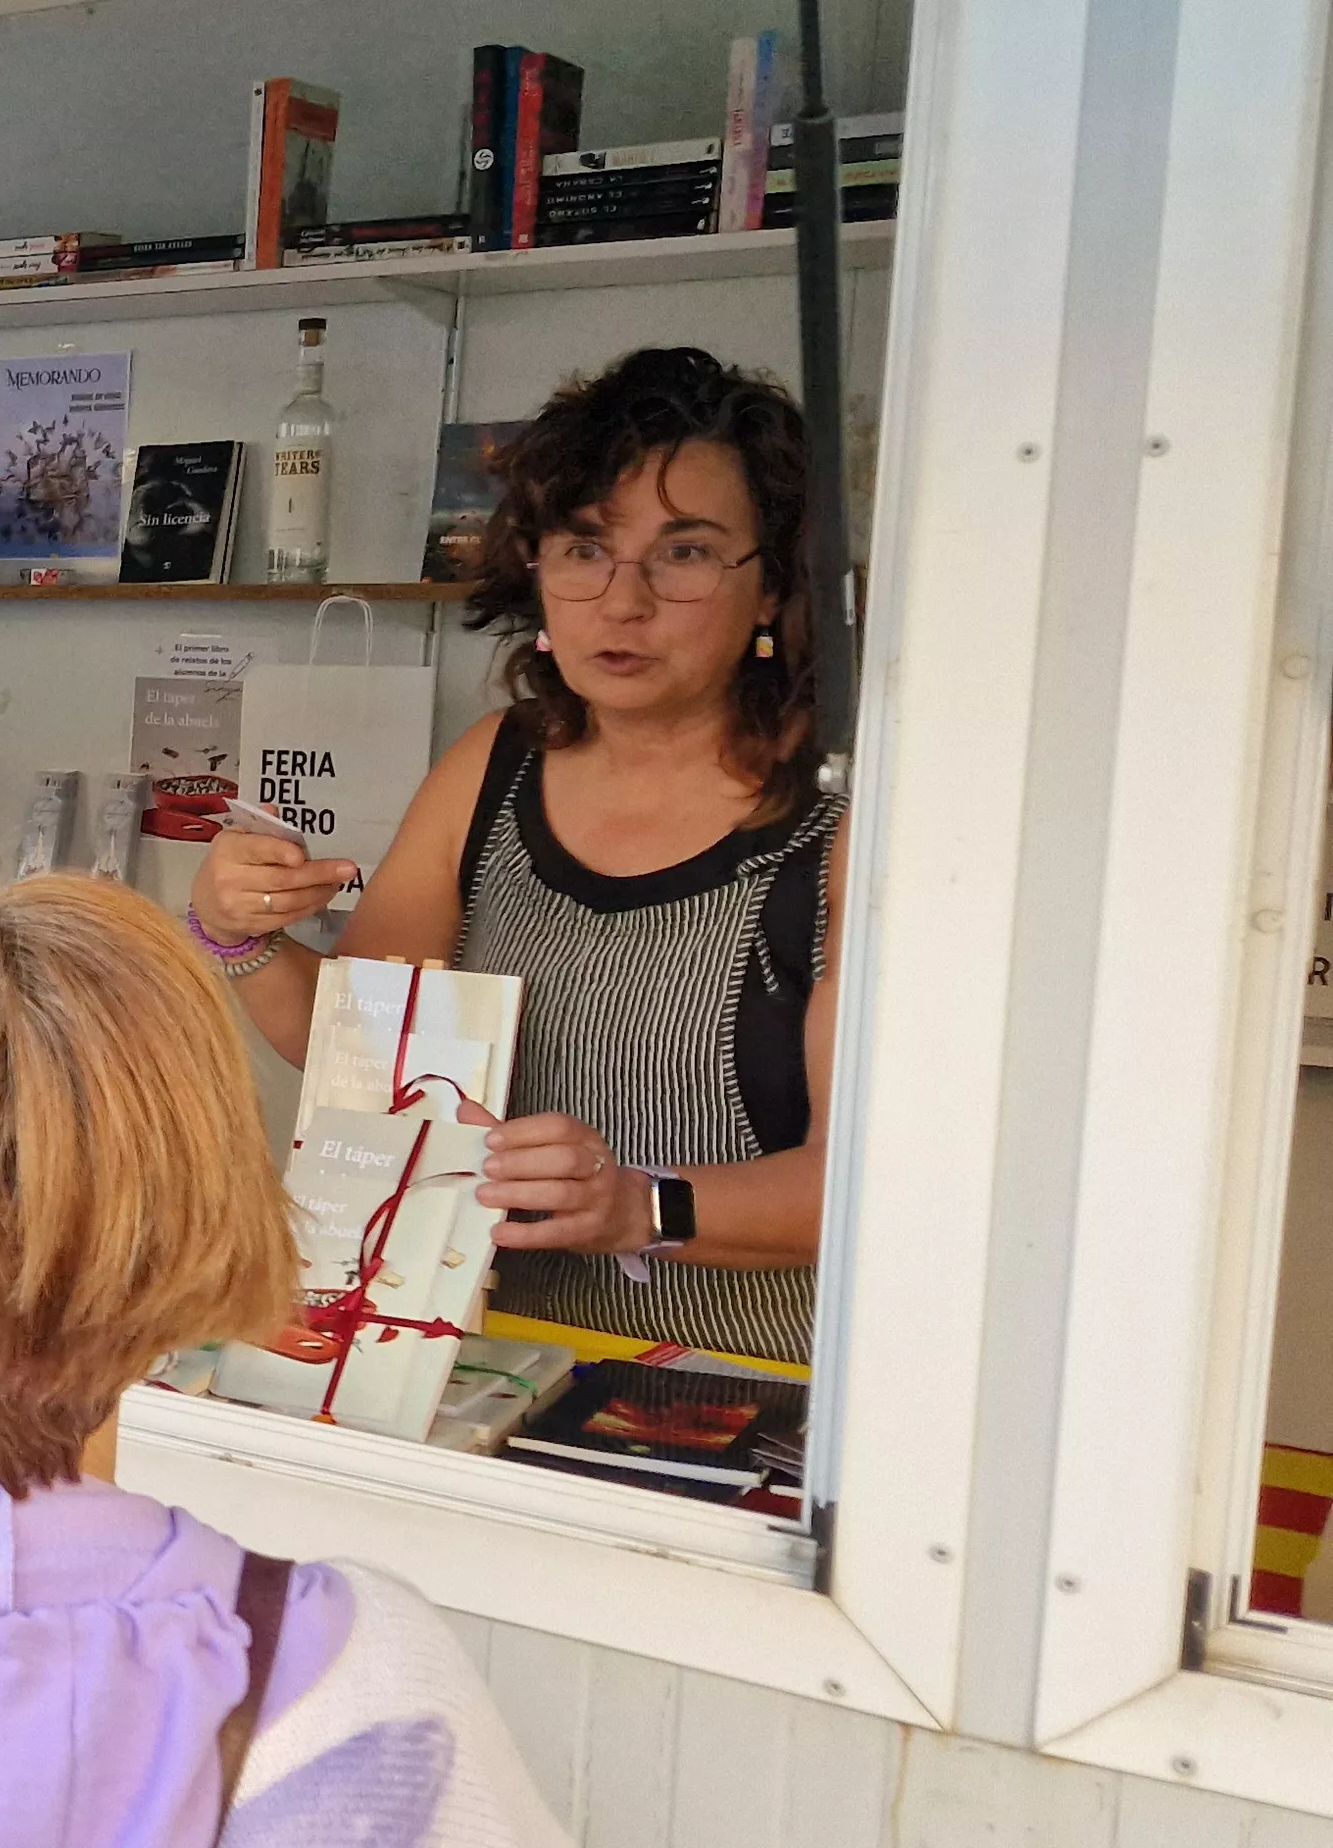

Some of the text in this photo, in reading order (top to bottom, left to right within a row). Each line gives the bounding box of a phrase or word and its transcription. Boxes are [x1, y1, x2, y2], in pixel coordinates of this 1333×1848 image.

[7, 367, 102, 391] MEMORANDO
[275, 460, 321, 477] TEARS
[138, 512, 211, 527] Sin licencia
[174, 643, 183, 652] El
[146, 688, 159, 703] El
[144, 711, 161, 726] de
[164, 711, 175, 726] la
[260, 749, 336, 778] FERIA
[259, 777, 306, 806] DEL
[281, 806, 336, 836] BRO
[334, 992, 405, 1018] El táper
[334, 1051, 350, 1066] El
[330, 1074, 393, 1093] de la abu
[318, 1139, 397, 1169] El táper
[318, 1221, 363, 1240] abuel
